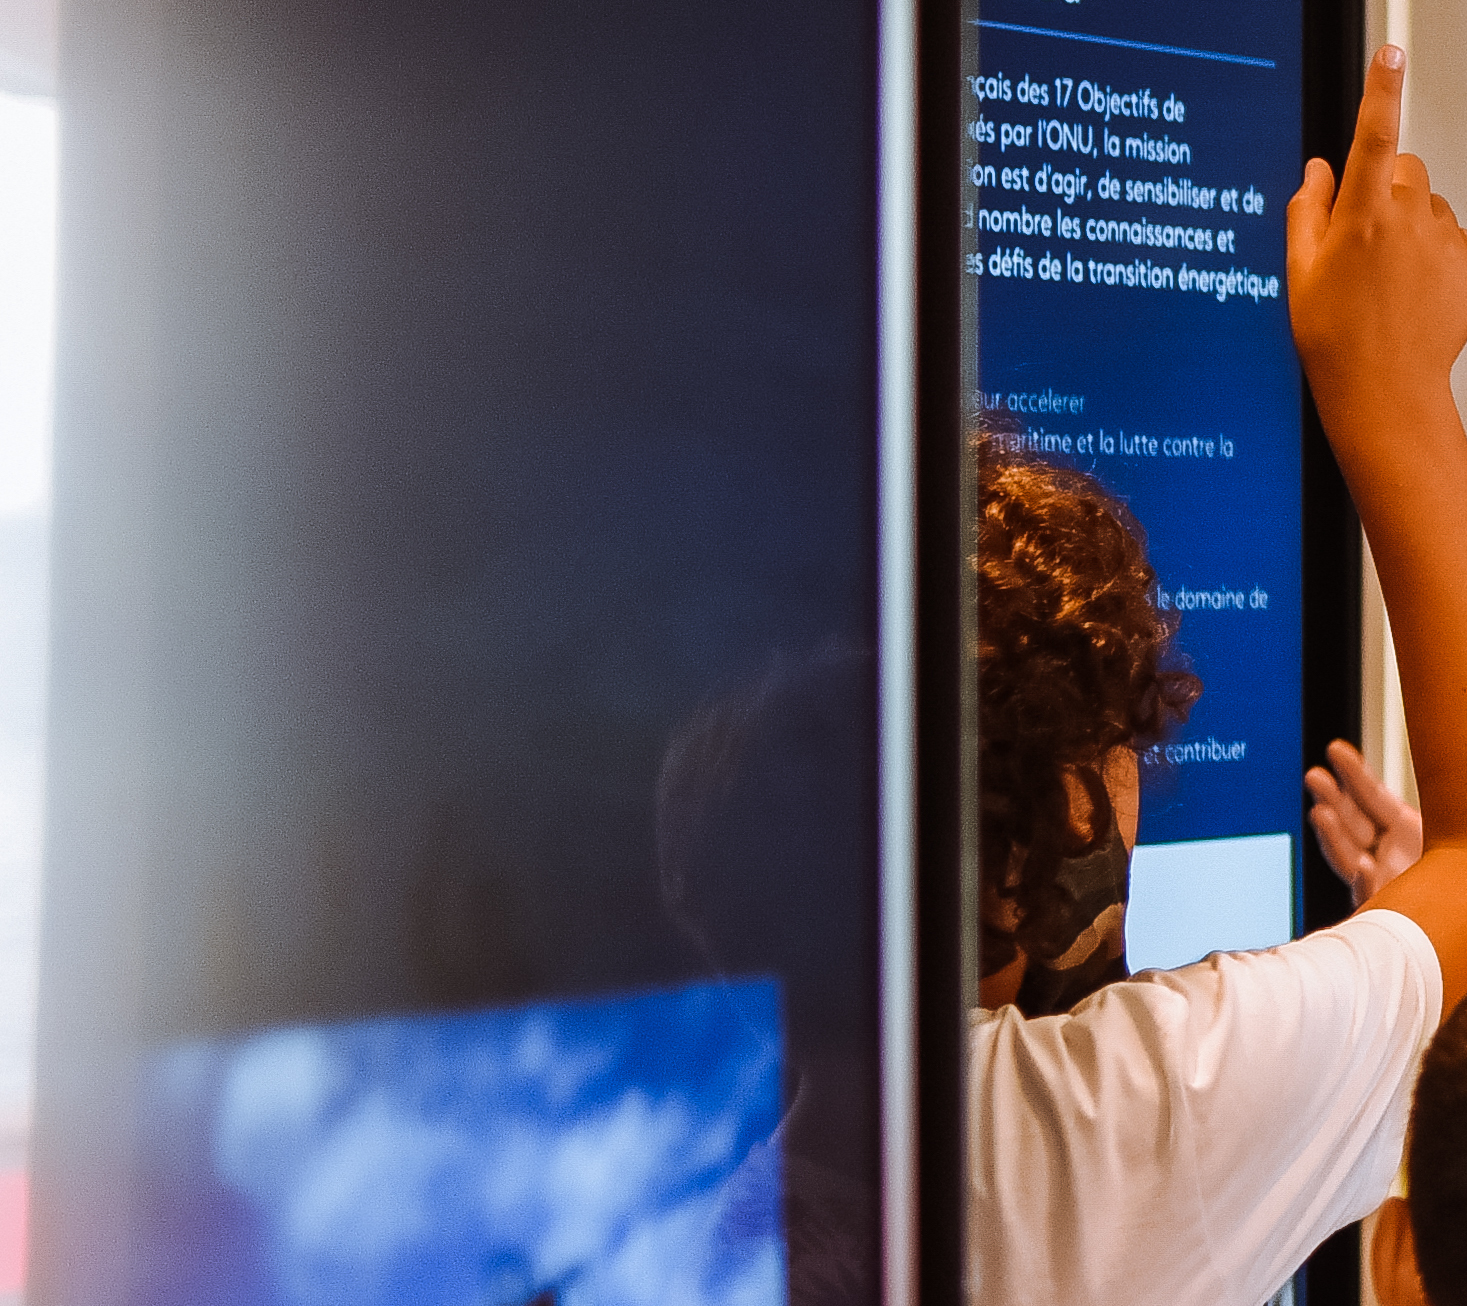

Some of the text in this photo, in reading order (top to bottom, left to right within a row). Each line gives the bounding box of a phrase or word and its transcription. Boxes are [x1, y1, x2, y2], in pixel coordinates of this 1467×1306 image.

[1017, 73, 1049, 106] des
[1055, 77, 1073, 107] 17
[1078, 80, 1159, 121] Objectifs
[1163, 93, 1185, 123] de
[1001, 122, 1032, 152] par
[1038, 119, 1097, 159] l'ONU,
[1104, 127, 1120, 157] la
[1126, 132, 1191, 165] mission
[966, 158, 1264, 215] on est d'agir, de sensibiliser et de
[979, 205, 1052, 237] nombre
[1057, 207, 1081, 239] les
[1086, 217, 1213, 252] connaissances
[1217, 228, 1235, 253] et
[988, 246, 1033, 279] défis
[1038, 251, 1061, 281] de
[1067, 251, 1083, 283] la
[1088, 258, 1173, 289] transition
[1179, 262, 1280, 303] énergétique
[1077, 433, 1093, 454] et
[1100, 428, 1115, 454] la
[1120, 429, 1158, 456] lutte
[1163, 436, 1214, 457] contre
[1220, 432, 1234, 458] la
[1175, 584, 1244, 610] domaine
[1250, 583, 1268, 609] de
[1165, 736, 1247, 764] contribuer
